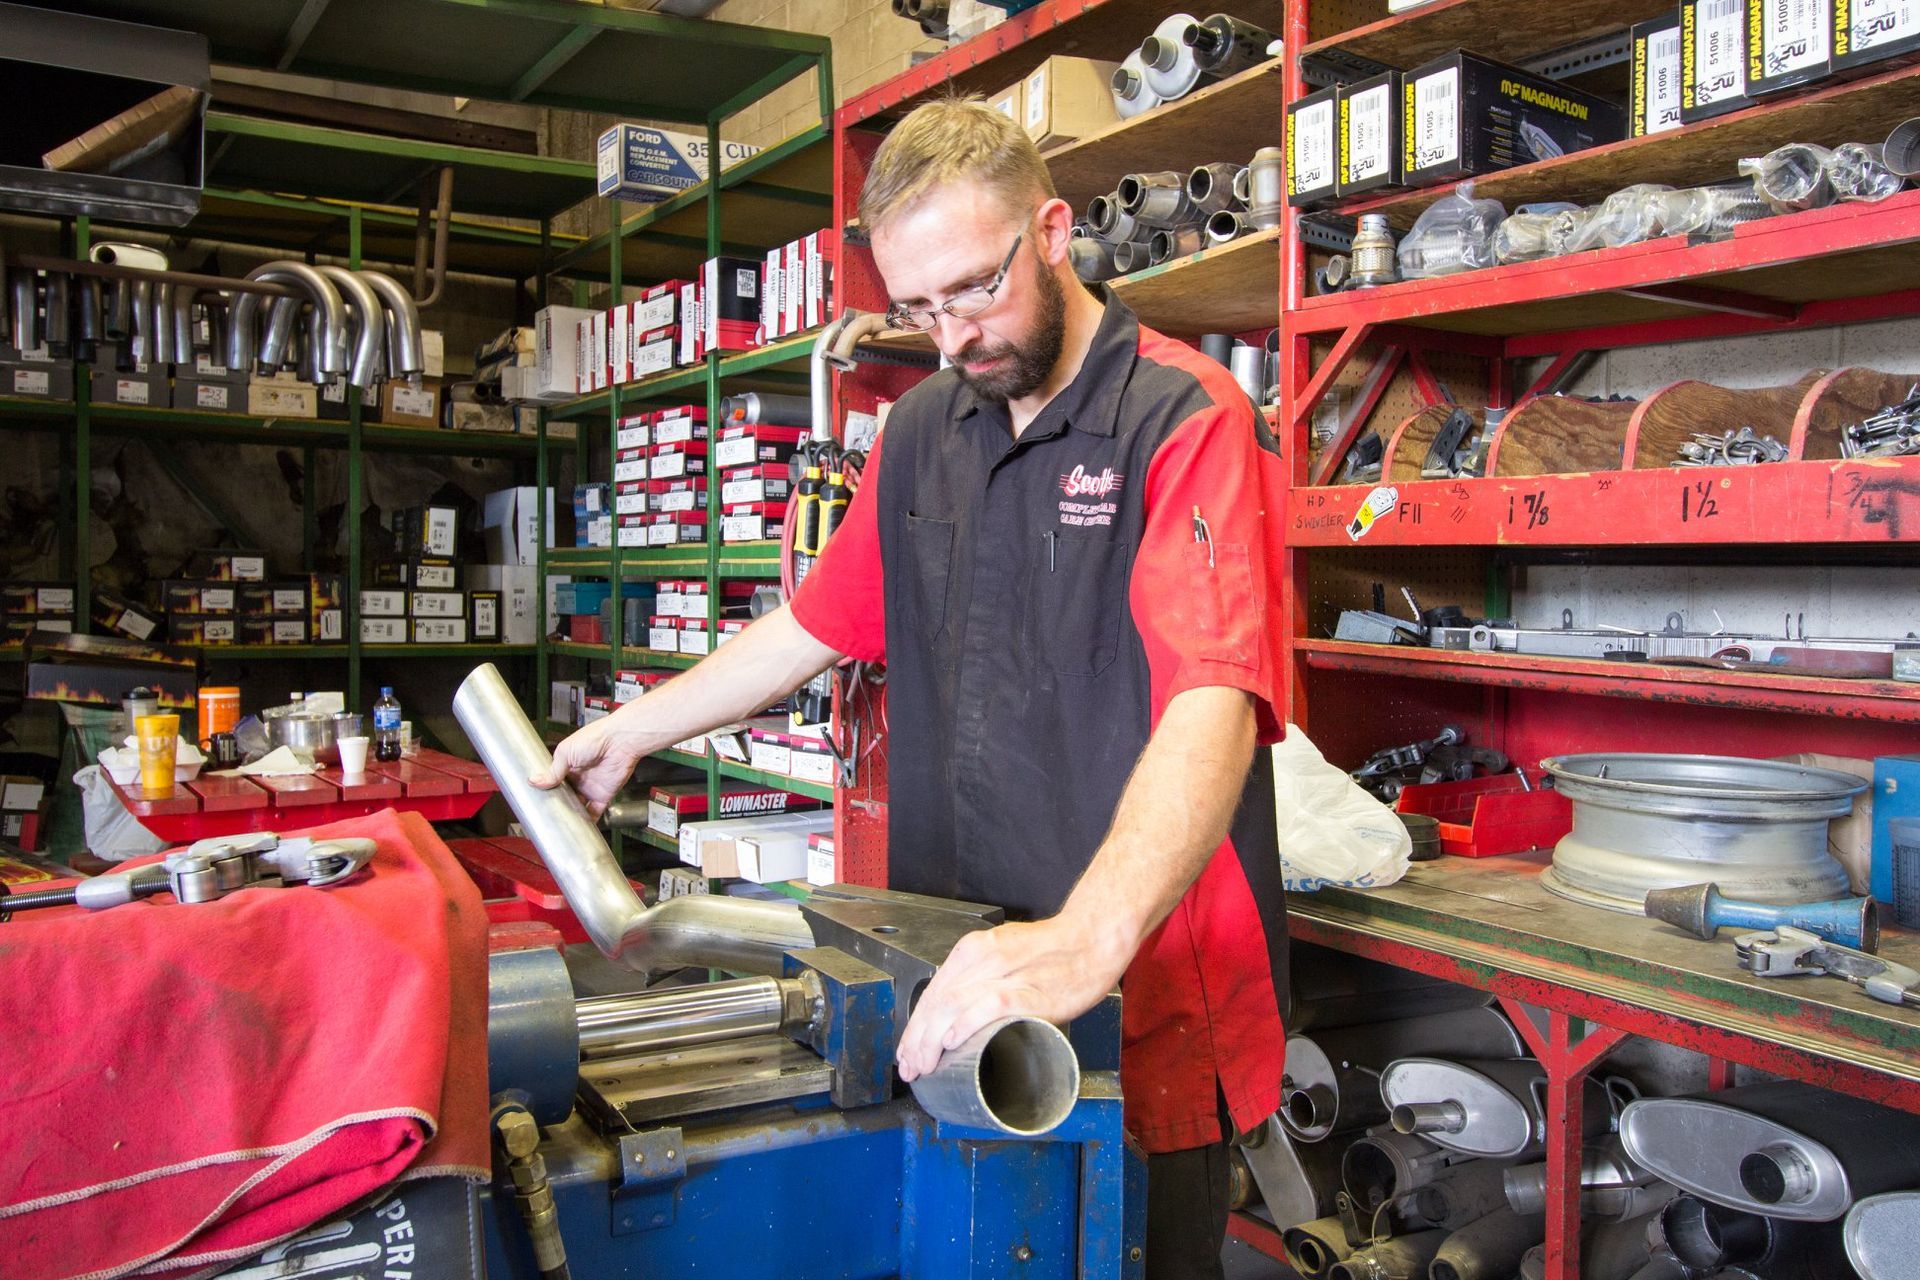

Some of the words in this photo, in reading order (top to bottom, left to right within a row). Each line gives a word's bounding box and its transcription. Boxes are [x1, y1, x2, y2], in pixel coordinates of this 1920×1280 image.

[1684, 4, 1694, 87] MAGNAFLOW
[1709, 31, 1719, 65] 51006
[1635, 38, 1645, 115] MAGNAFLOW
[1658, 67, 1667, 99] 51006
[1405, 84, 1414, 152] MAGNAFLOW
[1521, 86, 1588, 120] MAGNAFLOW
[629, 131, 661, 145] FORD
[1340, 99, 1349, 165] MAGNAFLOW
[1426, 110, 1434, 139] 51005
[629, 153, 678, 166] REPLACEMENT
[630, 146, 646, 154] NEW
[1287, 114, 1295, 177] MAGNAFLOW
[630, 159, 670, 171] CONVERTER
[1508, 495, 1514, 525] 1
[1524, 490, 1550, 530] 7/8
[1682, 486, 1689, 523] 1
[1696, 480, 1718, 518] 1/2
[720, 792, 788, 813] LOWMASTER
